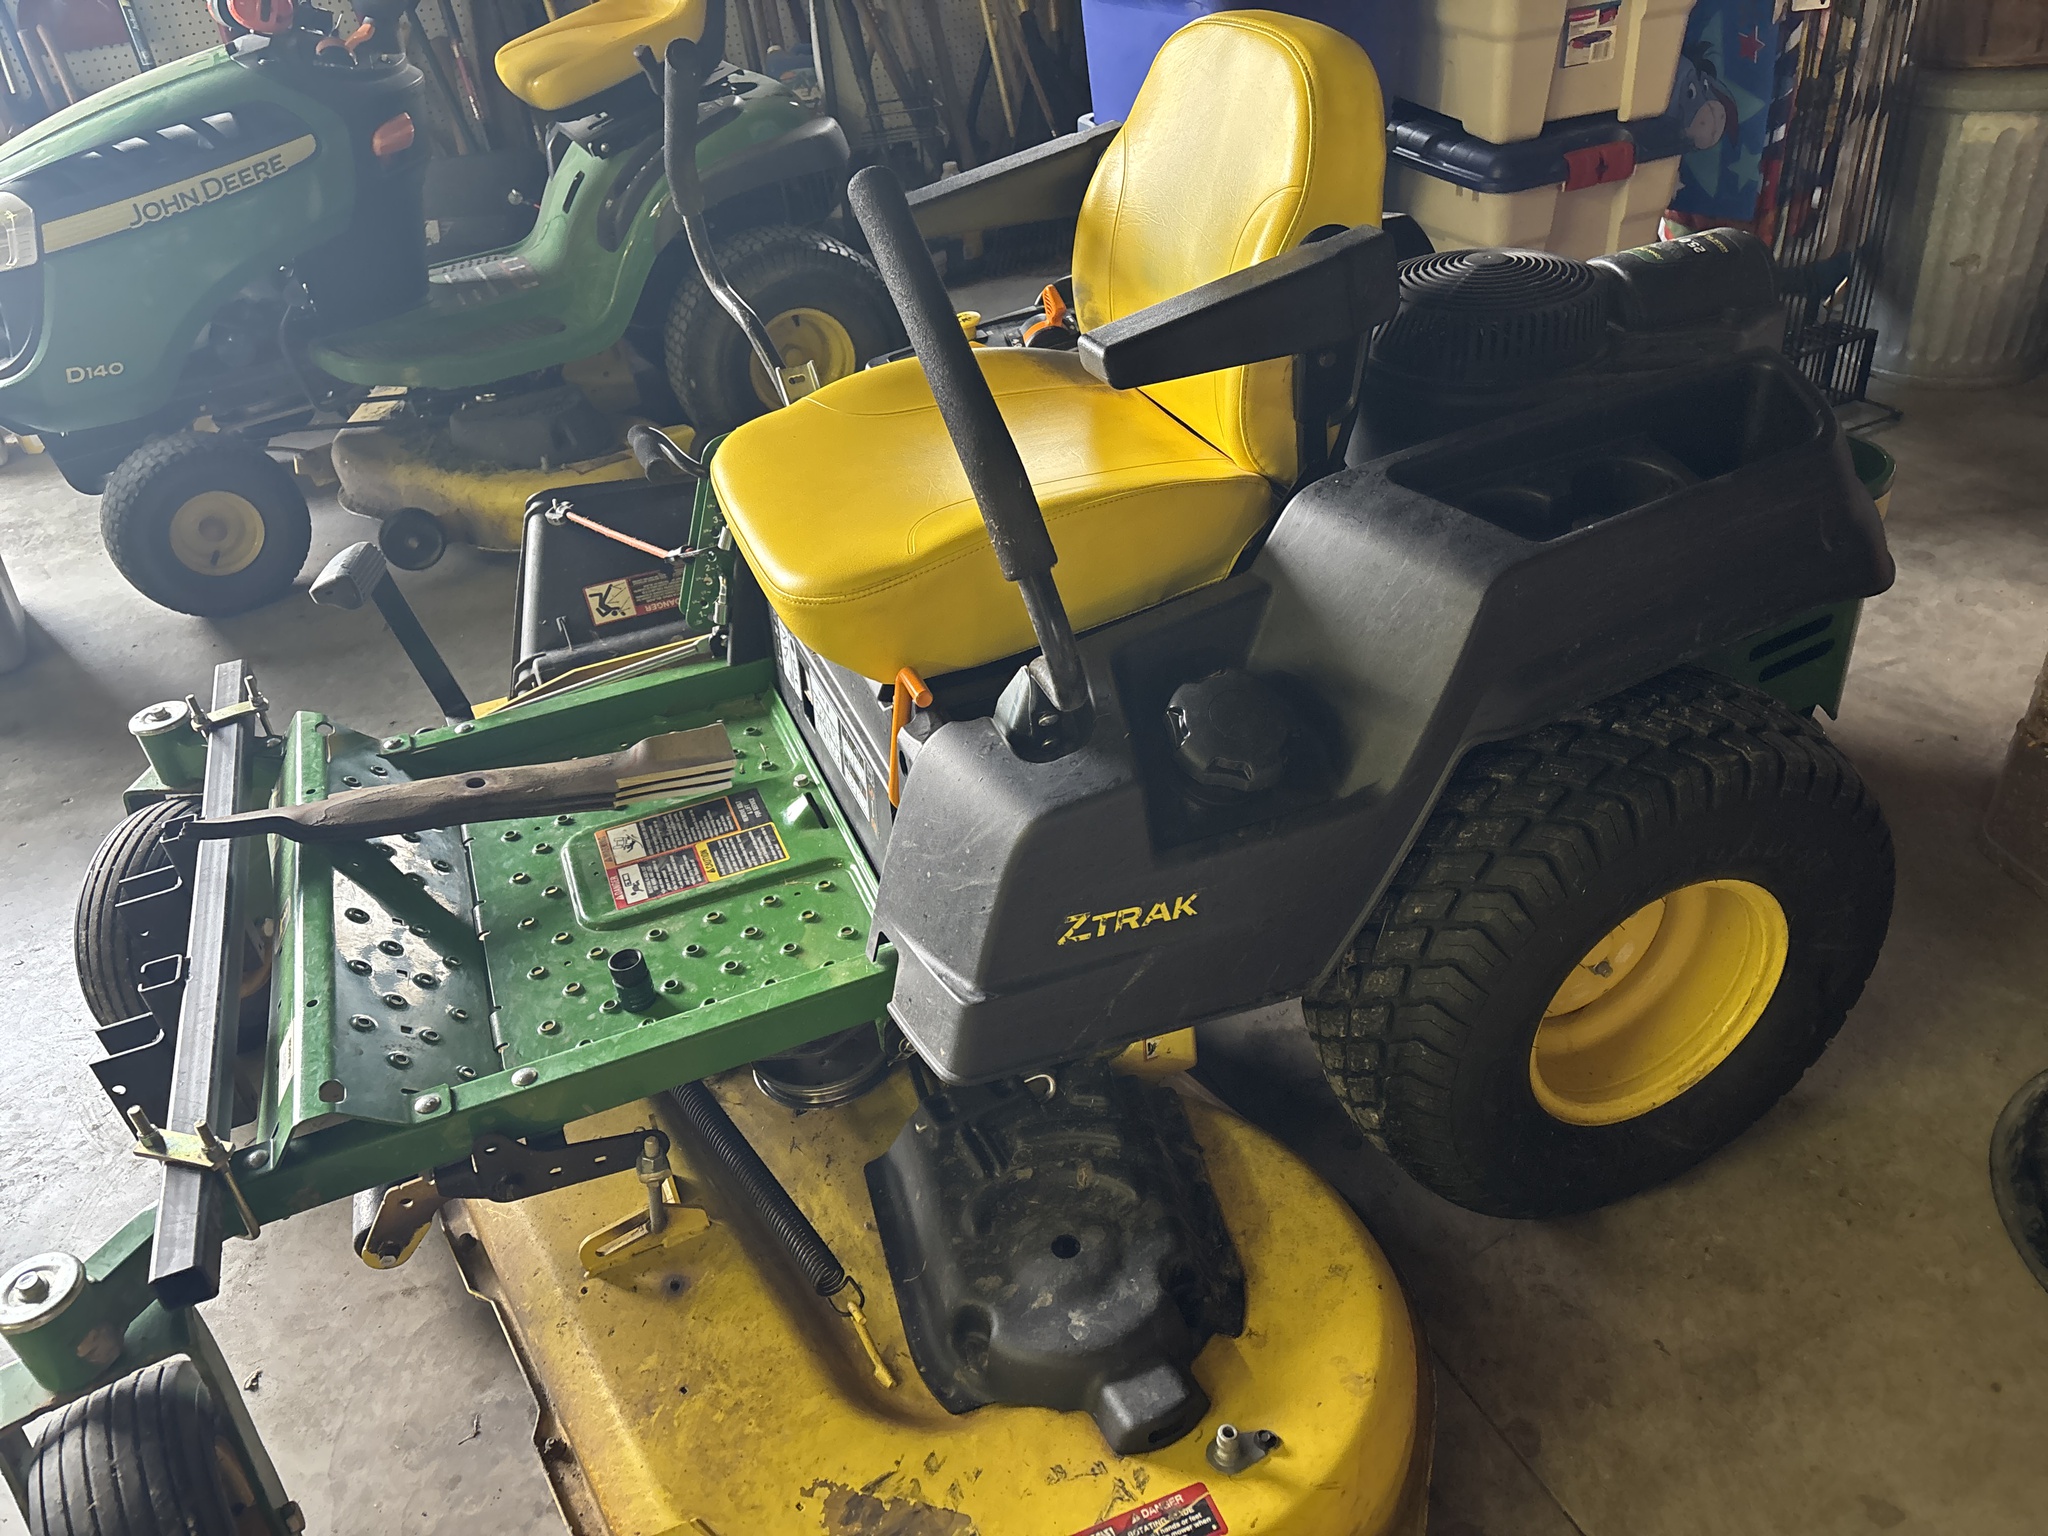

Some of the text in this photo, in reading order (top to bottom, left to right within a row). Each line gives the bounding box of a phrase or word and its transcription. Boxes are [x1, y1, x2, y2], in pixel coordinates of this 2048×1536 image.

[130, 154, 286, 227] JOHN DEERE
[66, 362, 124, 383] D140
[699, 849, 713, 868] CAUTION
[1057, 892, 1198, 946] ZTRAK
[1140, 1493, 1184, 1519] DANGER
[1159, 1520, 1181, 1534] hands
[1181, 1518, 1189, 1527] or
[1189, 1512, 1202, 1524] feet
[1169, 1524, 1193, 1536] mower
[1192, 1517, 1212, 1530] when
